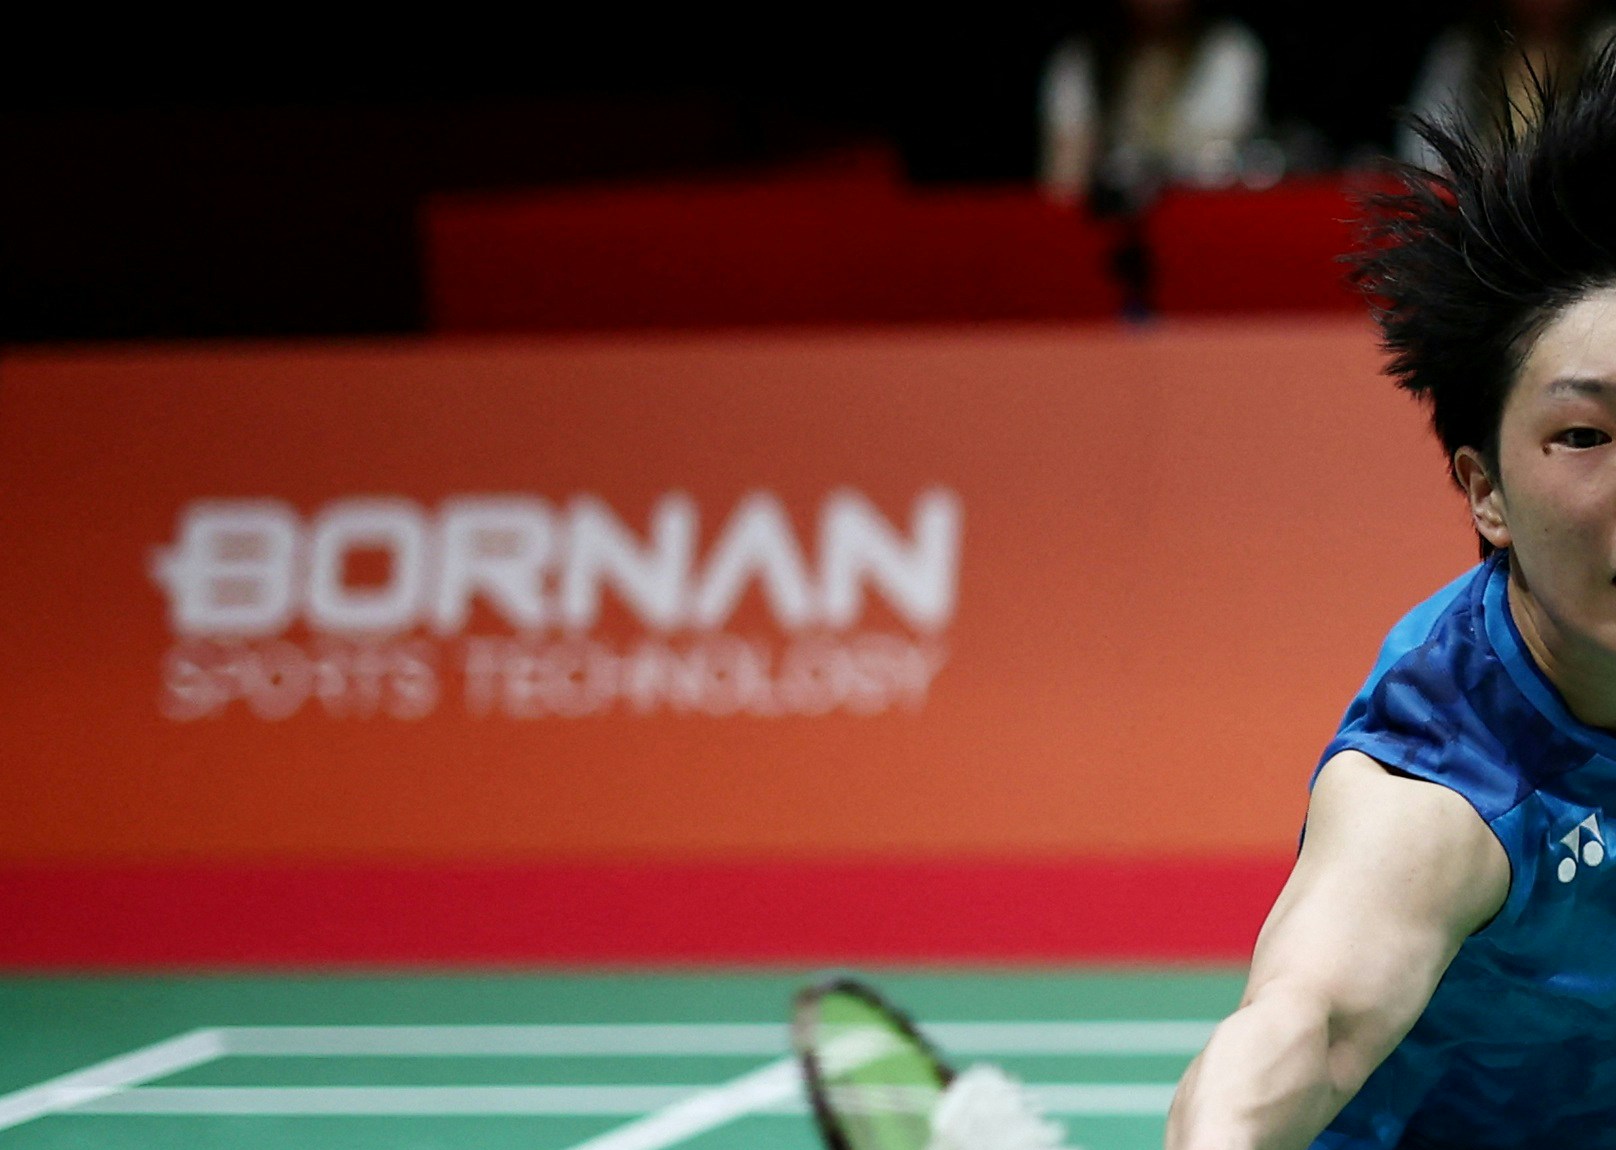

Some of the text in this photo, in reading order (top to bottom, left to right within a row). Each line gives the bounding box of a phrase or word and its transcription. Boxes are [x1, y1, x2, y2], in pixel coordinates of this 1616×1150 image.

[149, 487, 961, 633] BORNAN
[161, 632, 942, 719] SPORTS TECHNOLOGY
